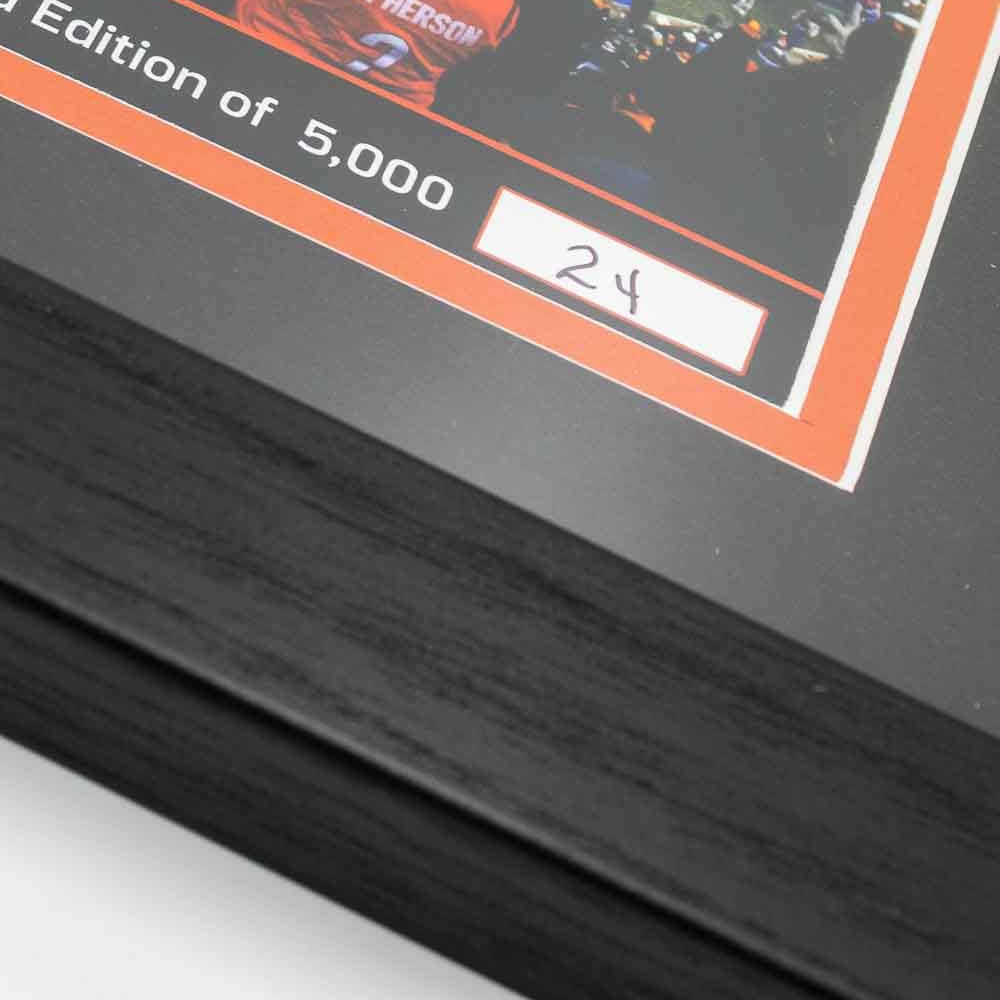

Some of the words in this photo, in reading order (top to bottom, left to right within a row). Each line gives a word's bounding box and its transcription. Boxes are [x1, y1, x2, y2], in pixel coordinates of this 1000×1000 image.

[219, 83, 278, 127] of
[296, 119, 453, 211] 5,000
[555, 244, 640, 315] 24
